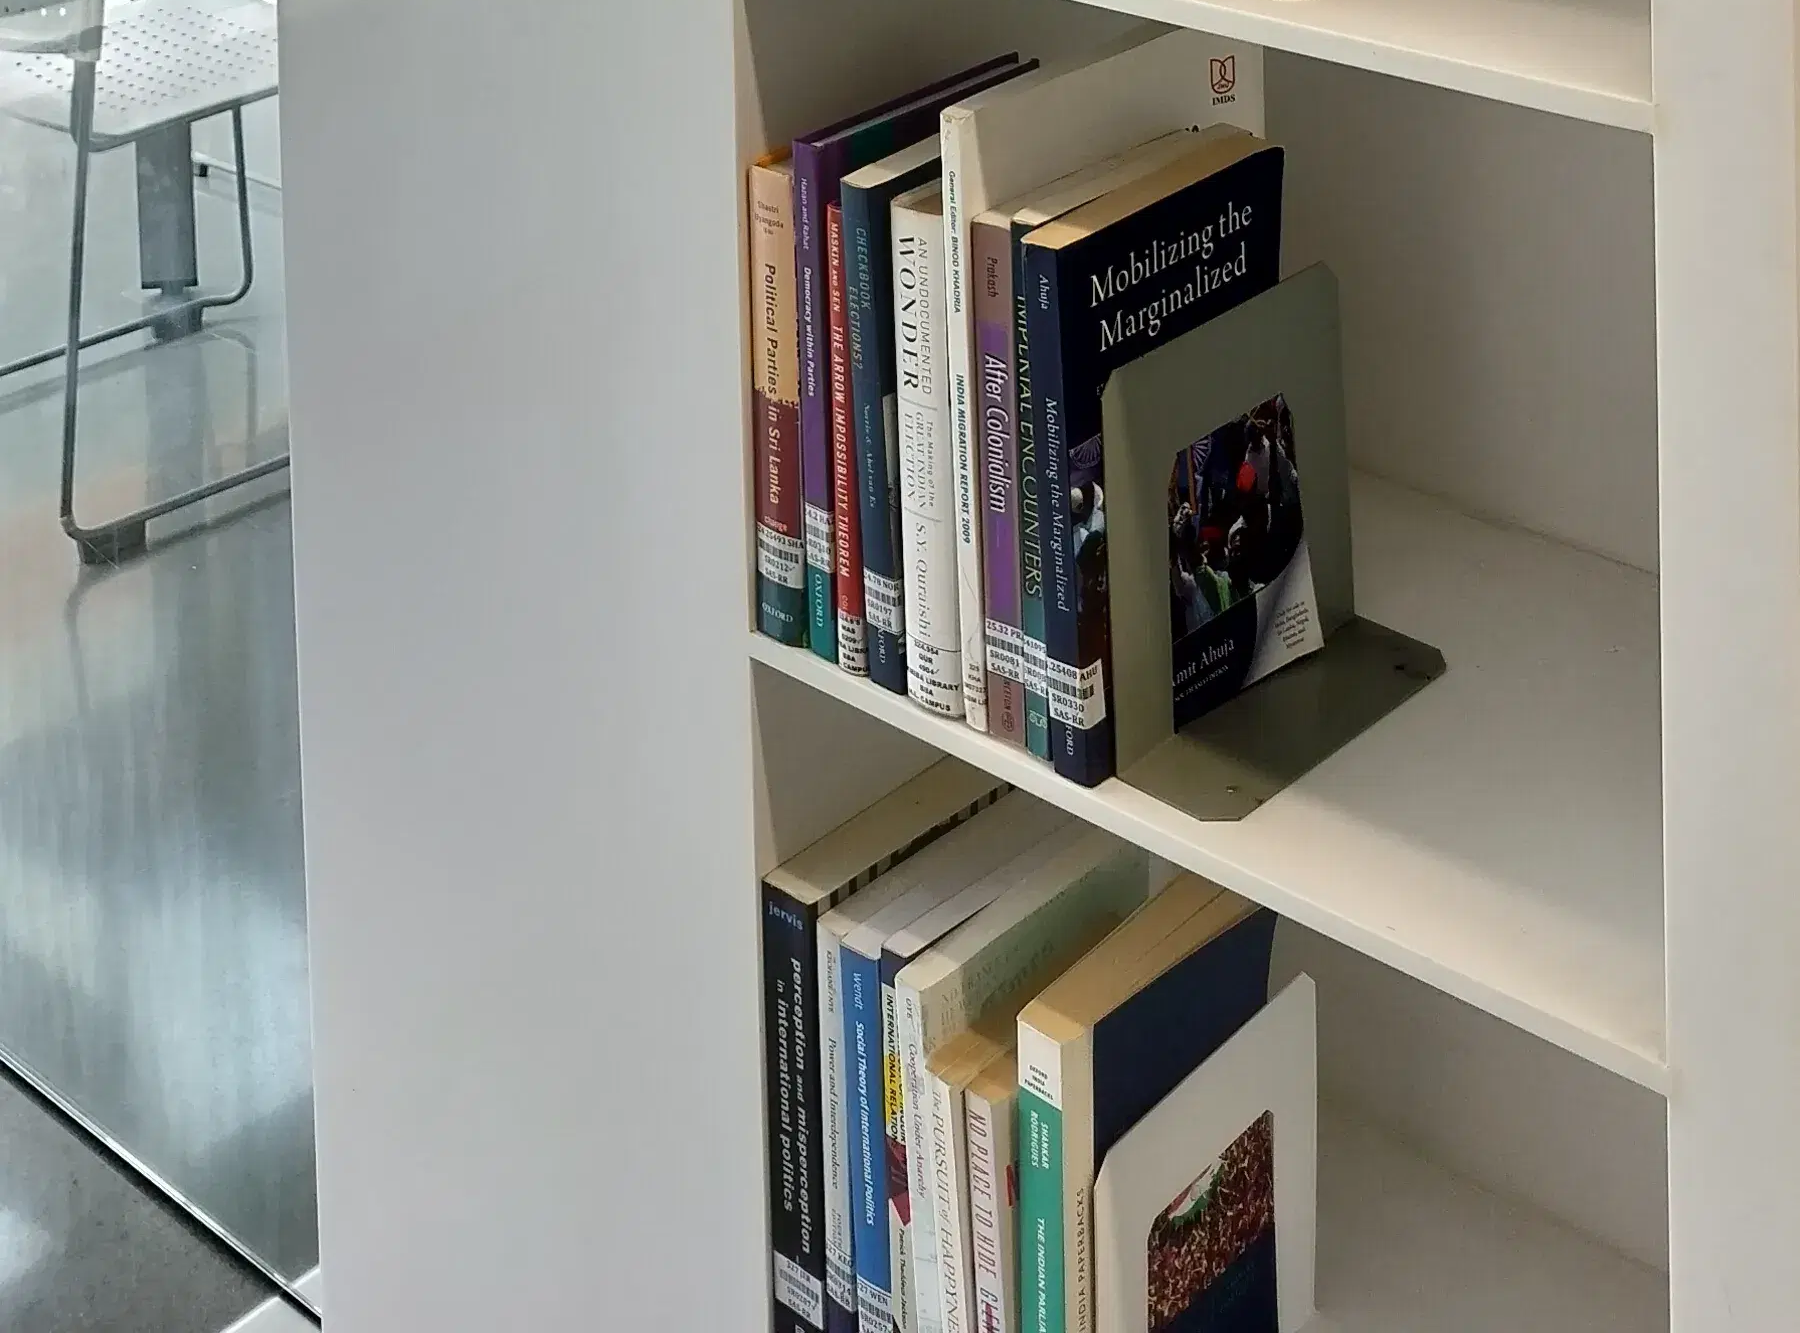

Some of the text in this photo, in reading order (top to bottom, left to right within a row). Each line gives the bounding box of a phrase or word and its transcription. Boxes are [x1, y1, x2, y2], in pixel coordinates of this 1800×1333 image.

[856, 227, 872, 312] CHECKBOOK
[898, 236, 920, 390] WONDER
[986, 256, 999, 298] Prakash
[1038, 274, 1051, 310] Ahuja
[1089, 200, 1253, 308] Mobilizing the
[1099, 241, 1248, 353] Marginalized
[802, 266, 817, 396] Democracy within Parties
[848, 285, 864, 370] ELECTIONS?
[917, 237, 934, 395] AN UNDOCUMENTED
[763, 262, 782, 505] Political Parties in Sri Lanka
[984, 353, 1012, 514] After Colonialism
[832, 324, 851, 578] THE ARROW IMPOSSIBILITY THEOREM
[956, 373, 972, 544] INDIA MIGRATION REPORT 2009
[1044, 396, 1071, 615] Mobilizing the Marginalized
[814, 573, 825, 627] OXFORD
[916, 522, 933, 638] S.Y. Quraishi
[1053, 707, 1085, 728] SAS-RR
[852, 972, 865, 1011] Wendt
[777, 979, 795, 1212] in international politics
[788, 957, 812, 1254] perception and misperception
[827, 1037, 841, 1190] Power and Interdependence
[856, 1020, 876, 1226] Social Theory of International Politics
[1030, 1109, 1040, 1168] RODRIGUES
[1040, 1121, 1050, 1169] SHANKAR
[969, 1109, 997, 1280] NO PLACE TO HIDE
[1036, 1217, 1046, 1288] THE INDIAN
